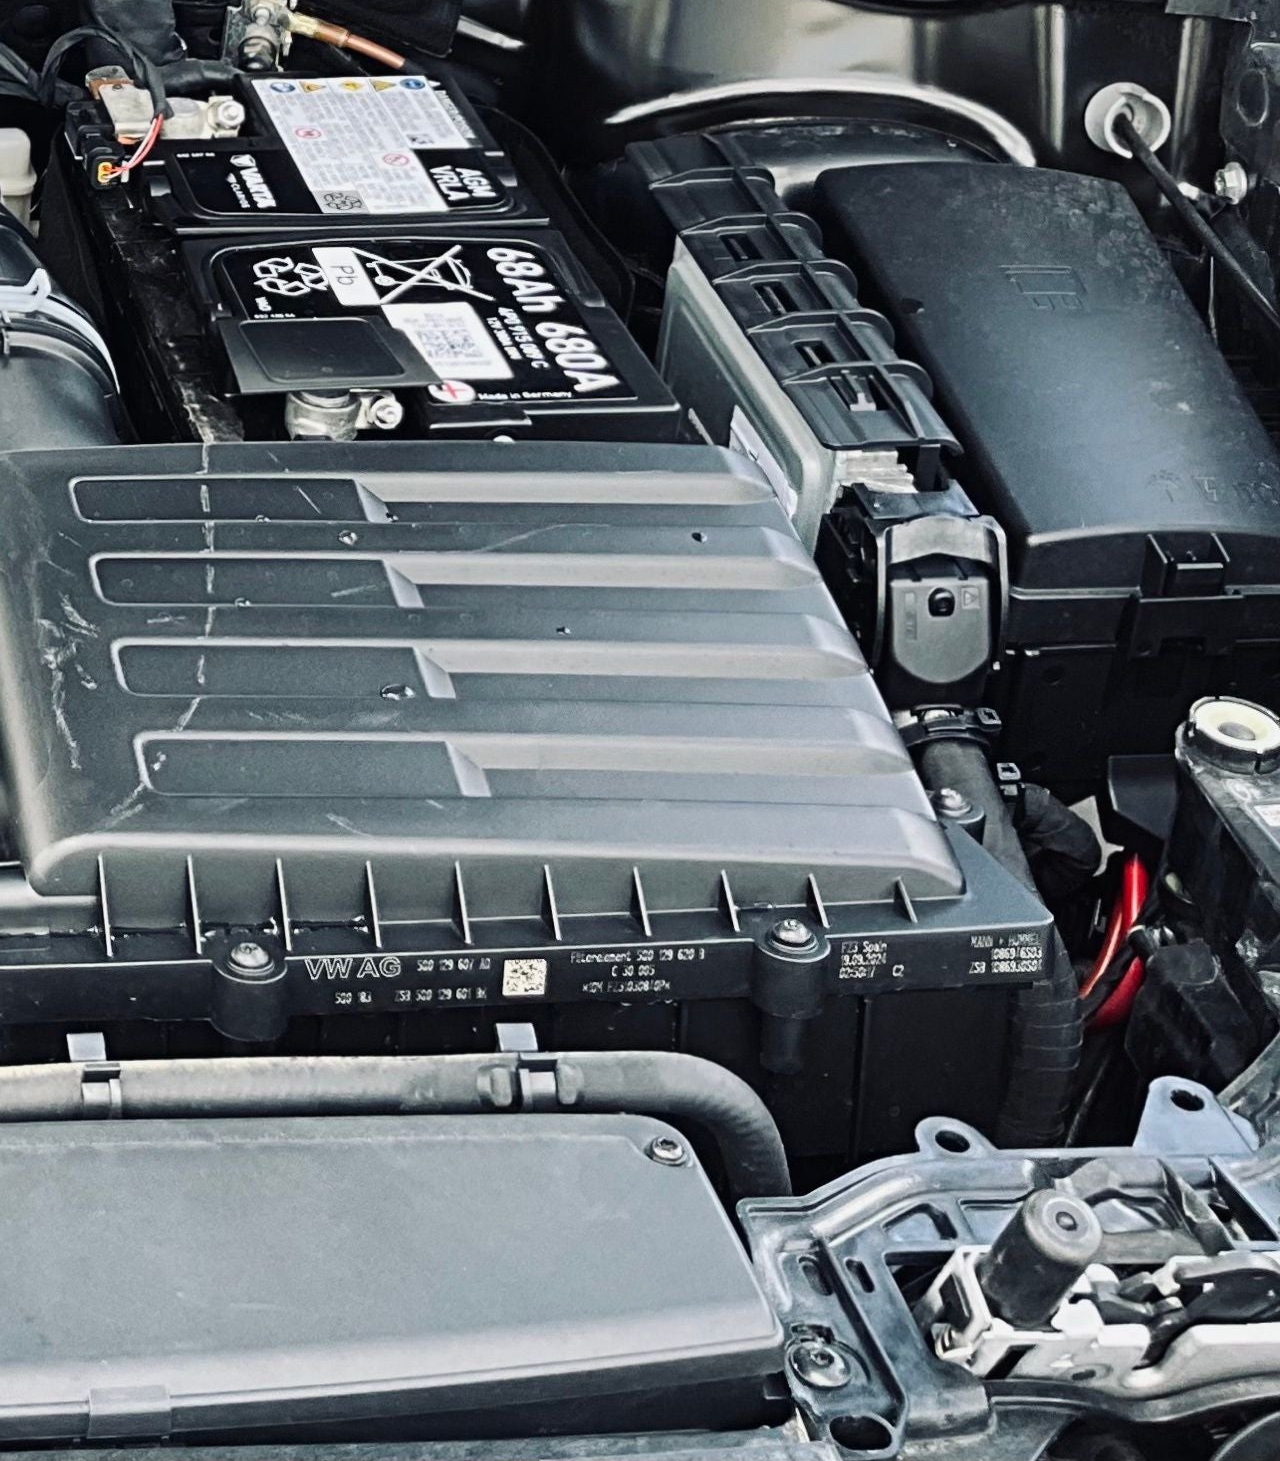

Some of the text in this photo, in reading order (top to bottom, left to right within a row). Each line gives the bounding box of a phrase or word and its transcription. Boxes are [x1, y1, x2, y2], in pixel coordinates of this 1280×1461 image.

[240, 166, 276, 208] VARTA
[429, 165, 470, 200] VRLA
[454, 168, 498, 196] AGM
[330, 266, 360, 285] Pb
[486, 247, 621, 392] 68Ah 680A
[508, 325, 534, 342] 915
[530, 360, 550, 369] C
[863, 940, 887, 952] Spain
[304, 957, 353, 980] VW
[357, 956, 401, 978] AG
[612, 965, 618, 976] C
[892, 964, 904, 977] C2
